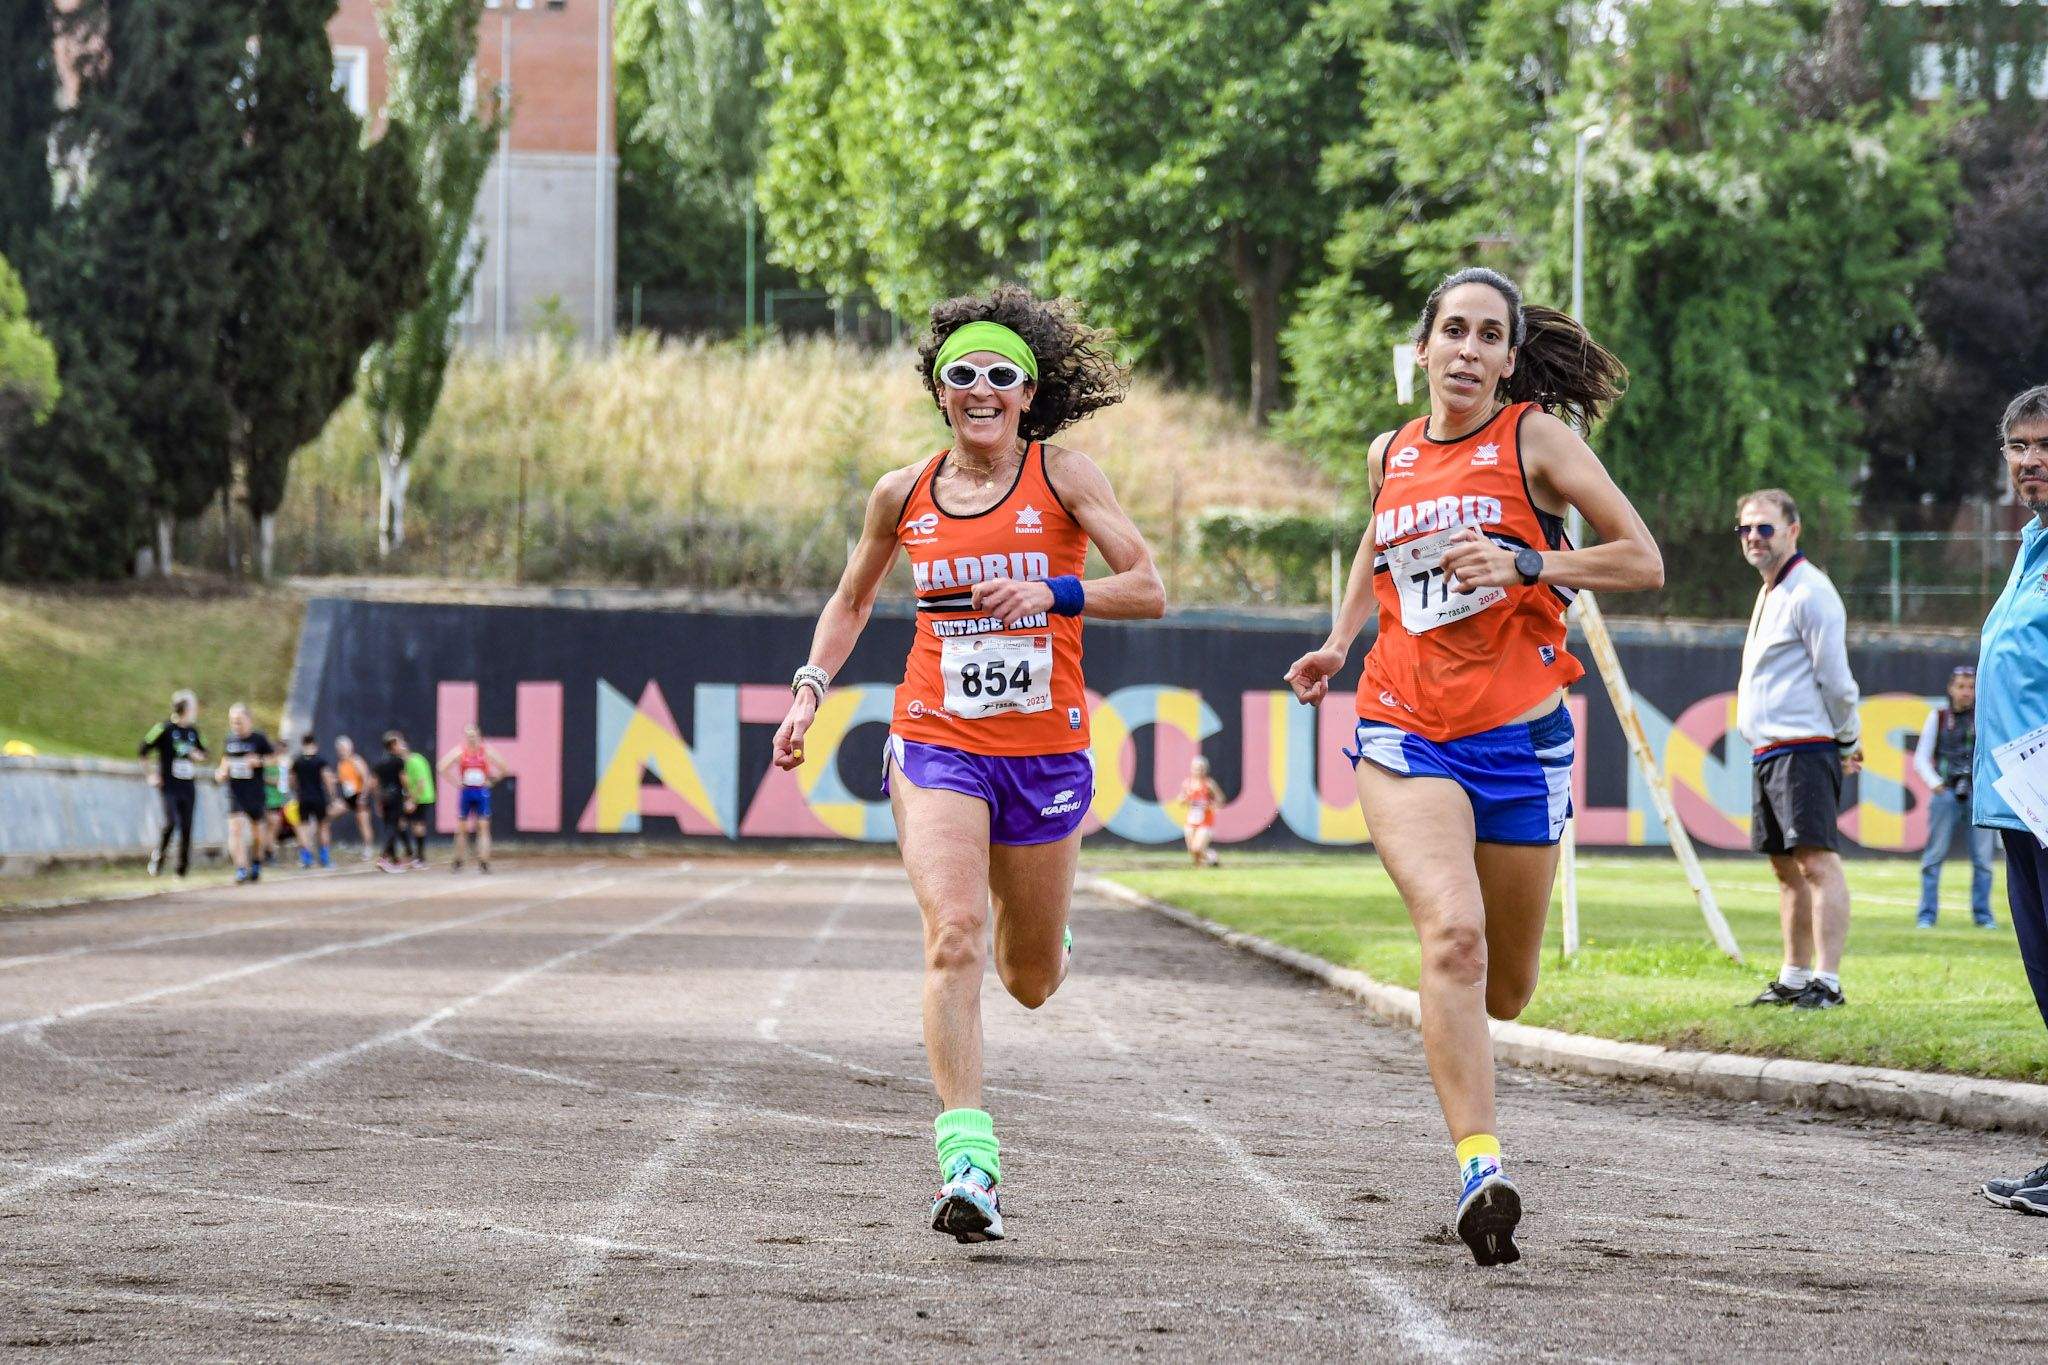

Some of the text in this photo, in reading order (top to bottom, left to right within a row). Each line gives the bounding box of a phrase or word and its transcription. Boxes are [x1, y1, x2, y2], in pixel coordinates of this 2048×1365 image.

[1375, 495, 1502, 546] MADRID
[912, 551, 1049, 592] MADRID
[931, 616, 1004, 637] VINTAGE
[960, 660, 1032, 698] 854
[1040, 800, 1082, 817] KARHU
